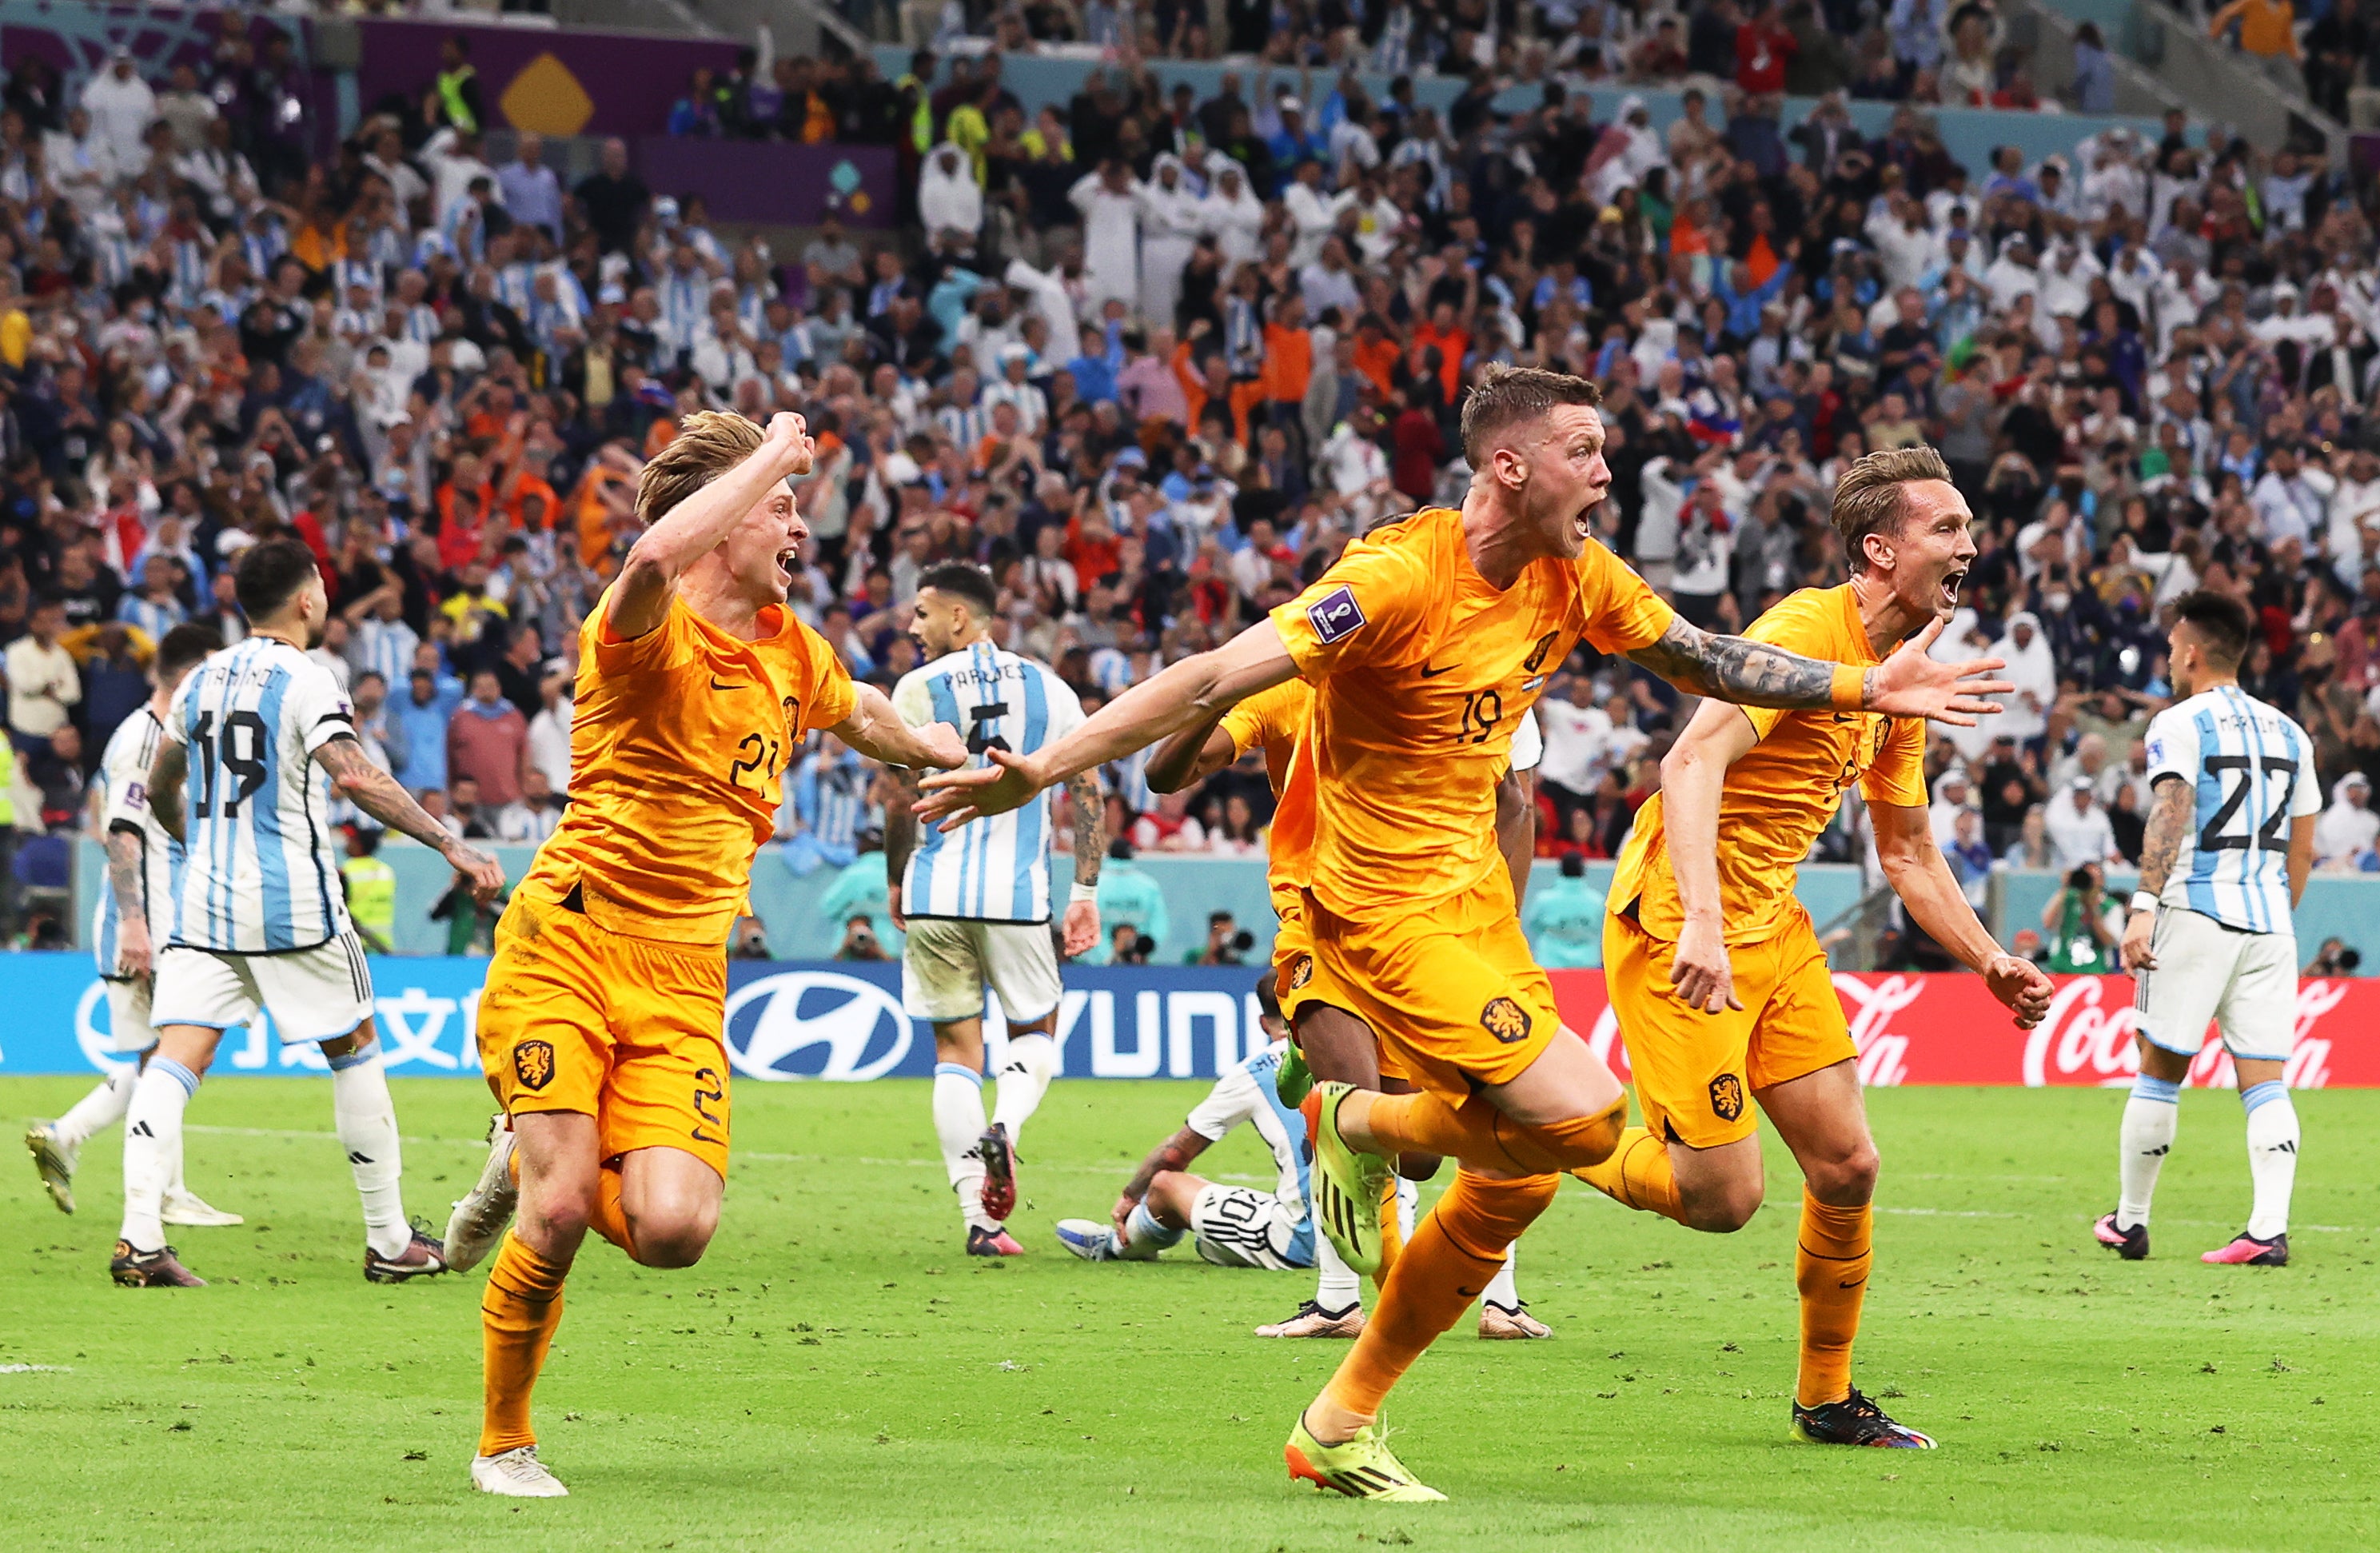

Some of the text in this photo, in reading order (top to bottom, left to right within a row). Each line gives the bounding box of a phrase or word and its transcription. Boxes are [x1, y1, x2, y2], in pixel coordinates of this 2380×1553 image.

[967, 702, 1012, 755] 5
[1457, 689, 1502, 744] 19
[189, 709, 267, 819] 19
[729, 732, 779, 799] 21
[2200, 755, 2299, 853] 22
